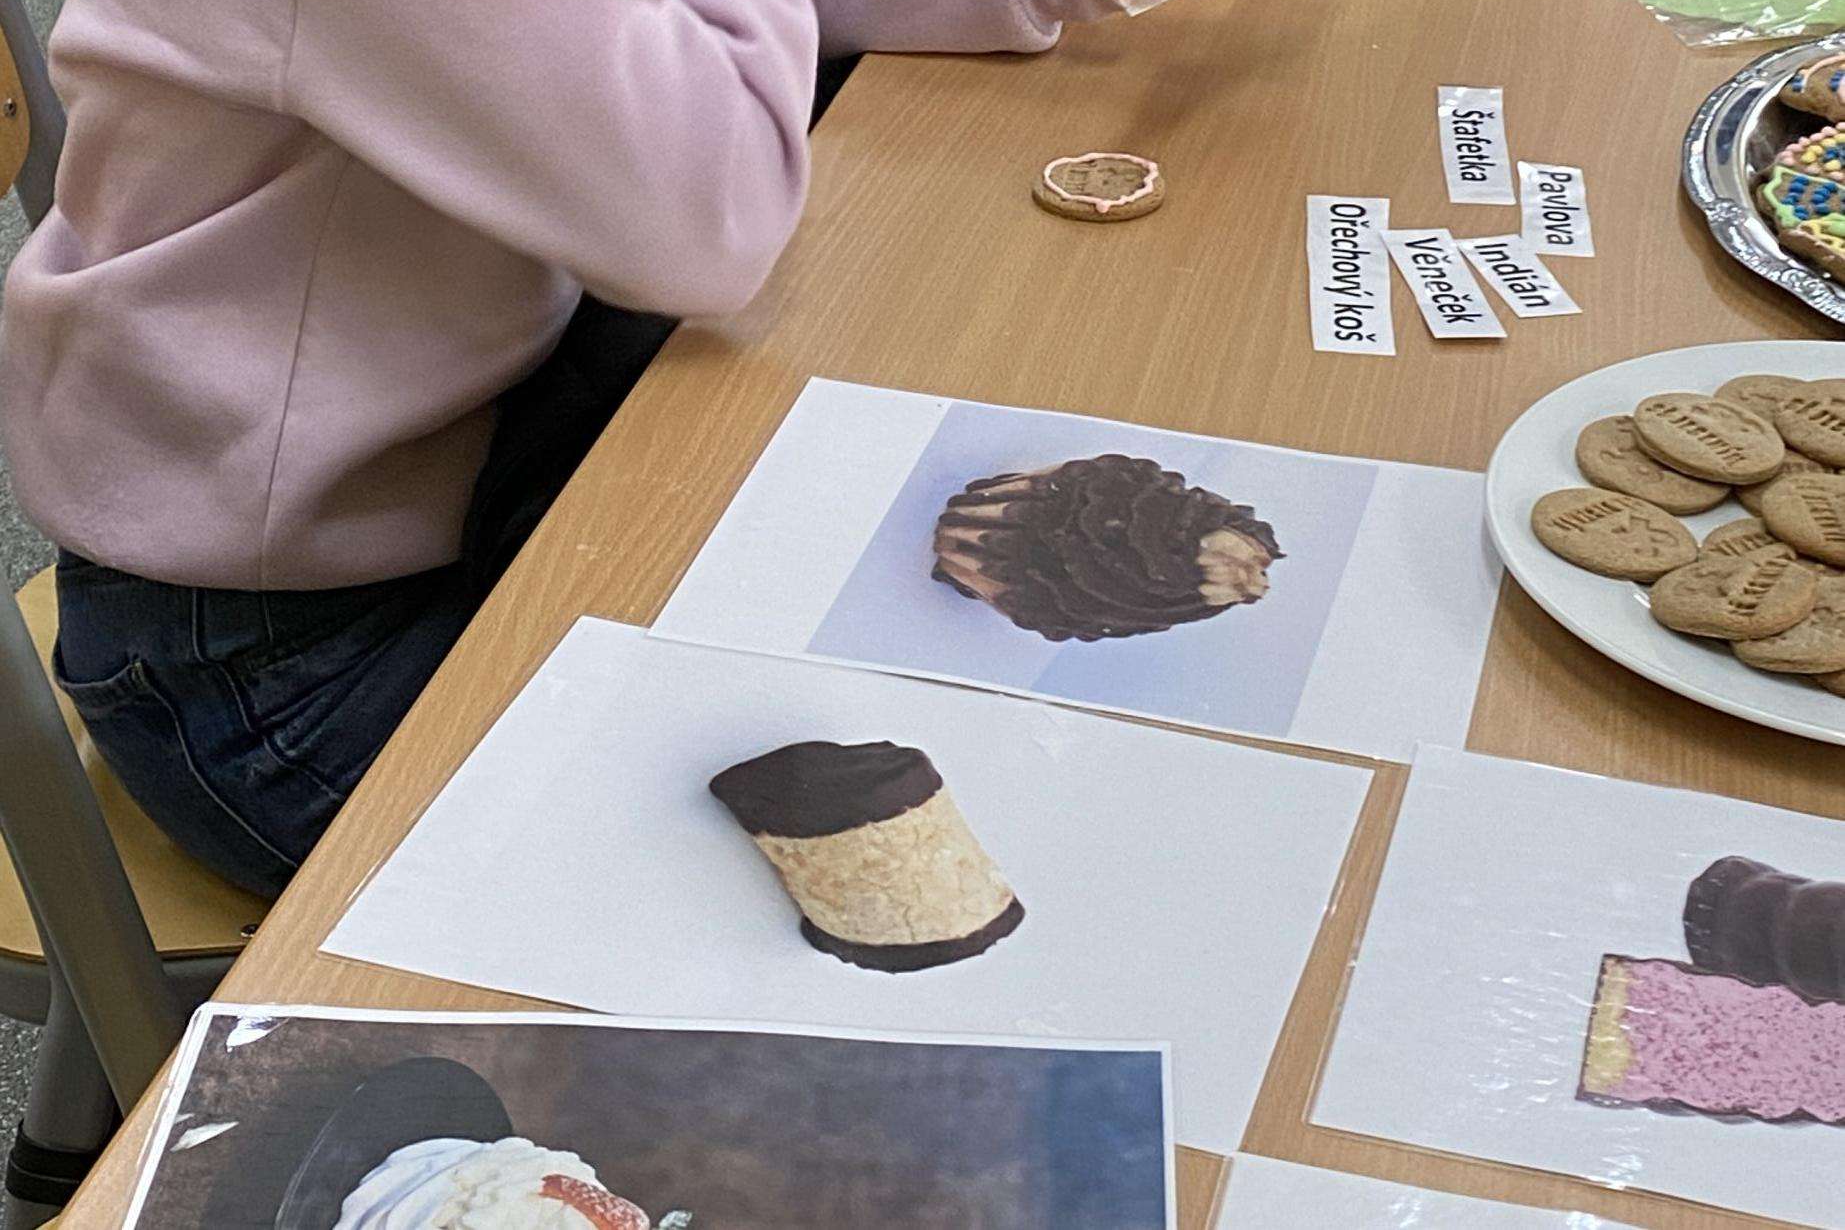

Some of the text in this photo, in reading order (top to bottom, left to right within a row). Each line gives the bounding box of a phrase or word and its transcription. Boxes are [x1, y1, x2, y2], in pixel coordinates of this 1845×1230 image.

[1451, 109, 1497, 182] Štafetka
[1538, 171, 1581, 245] Pavlova
[1323, 203, 1376, 342] Ořechový koš
[1404, 237, 1483, 324] Věneček
[1474, 243, 1551, 308] Indián
